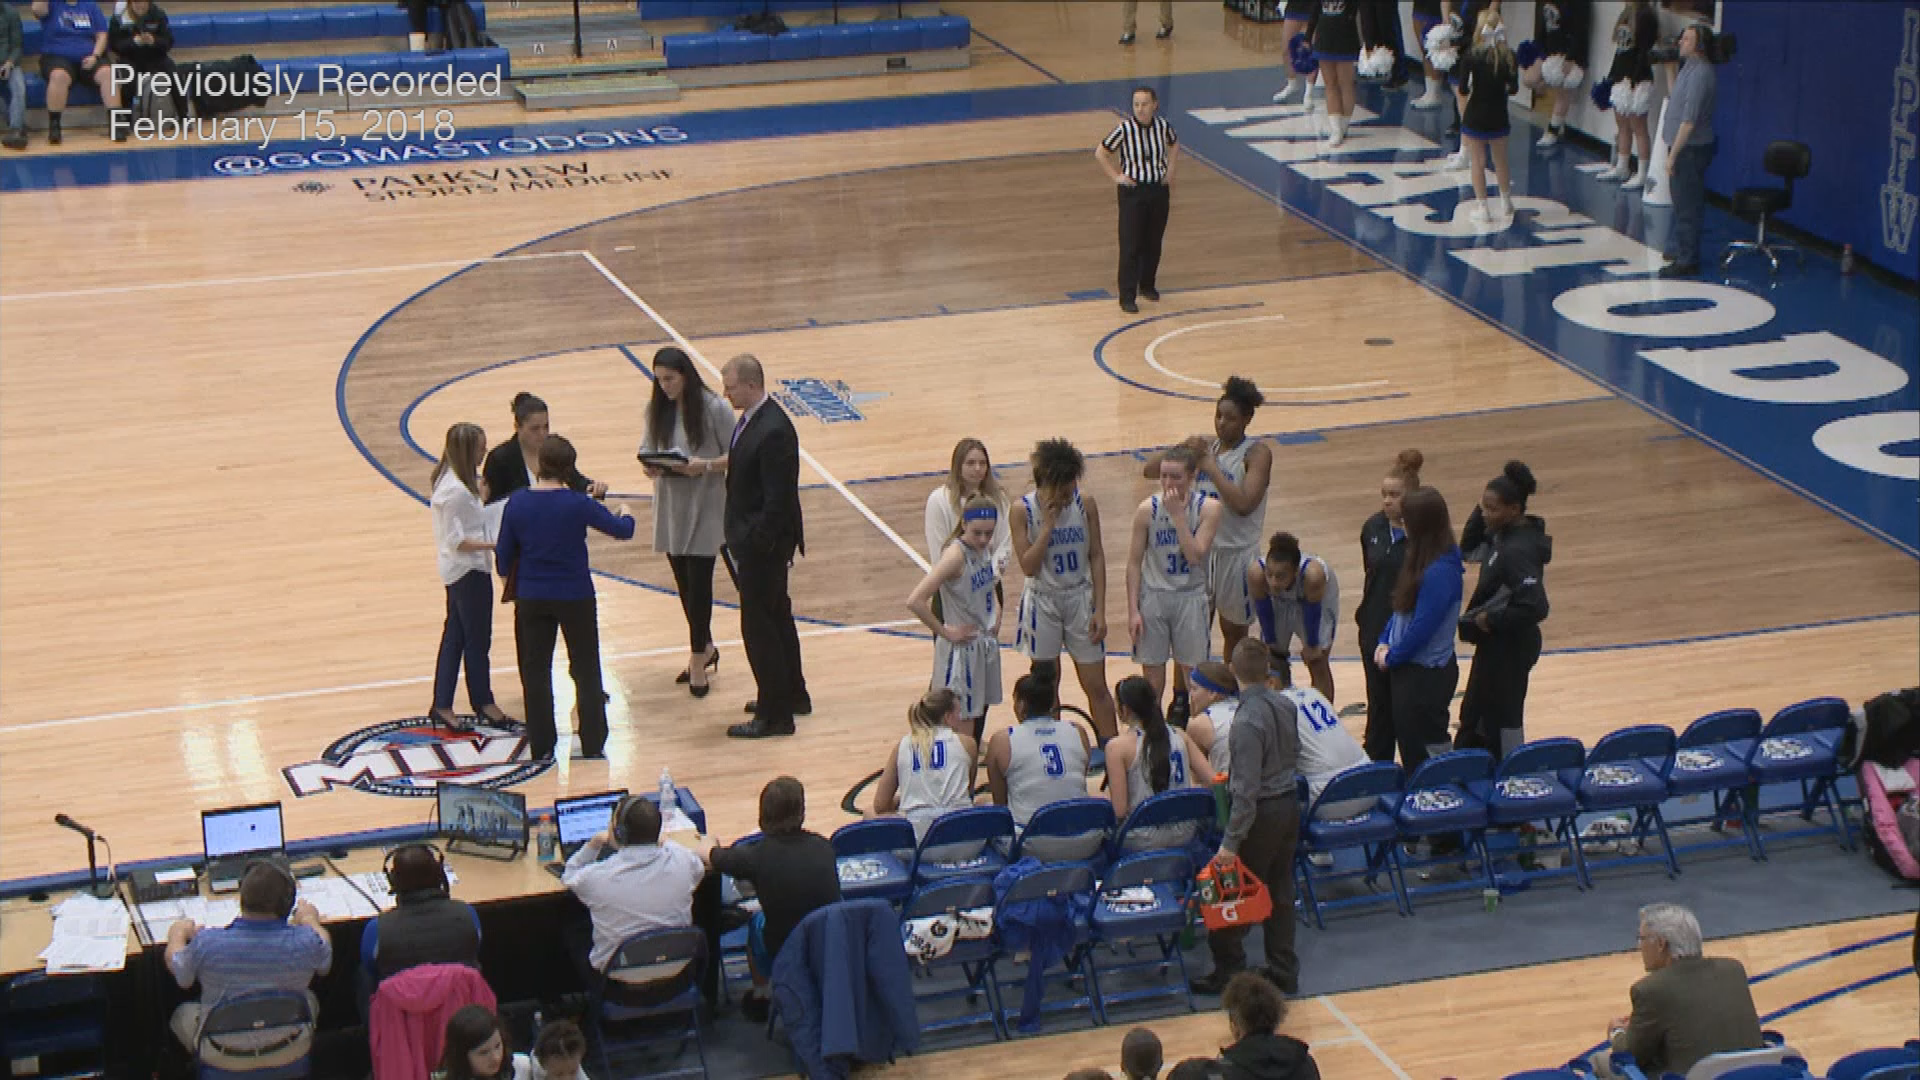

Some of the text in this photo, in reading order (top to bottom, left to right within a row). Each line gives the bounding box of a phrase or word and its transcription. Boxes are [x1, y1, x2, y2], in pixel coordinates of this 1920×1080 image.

[213, 125, 688, 175] @GOMASTODONS
[352, 161, 588, 191] PARKVIEW
[364, 169, 673, 201] SPORTS MEDICINE
[1052, 550, 1078, 575] 30
[1167, 553, 1190, 575] 32
[1299, 699, 1338, 733] 12
[281, 732, 578, 798] MIV
[912, 740, 945, 772] 10
[1041, 743, 1065, 778] 3
